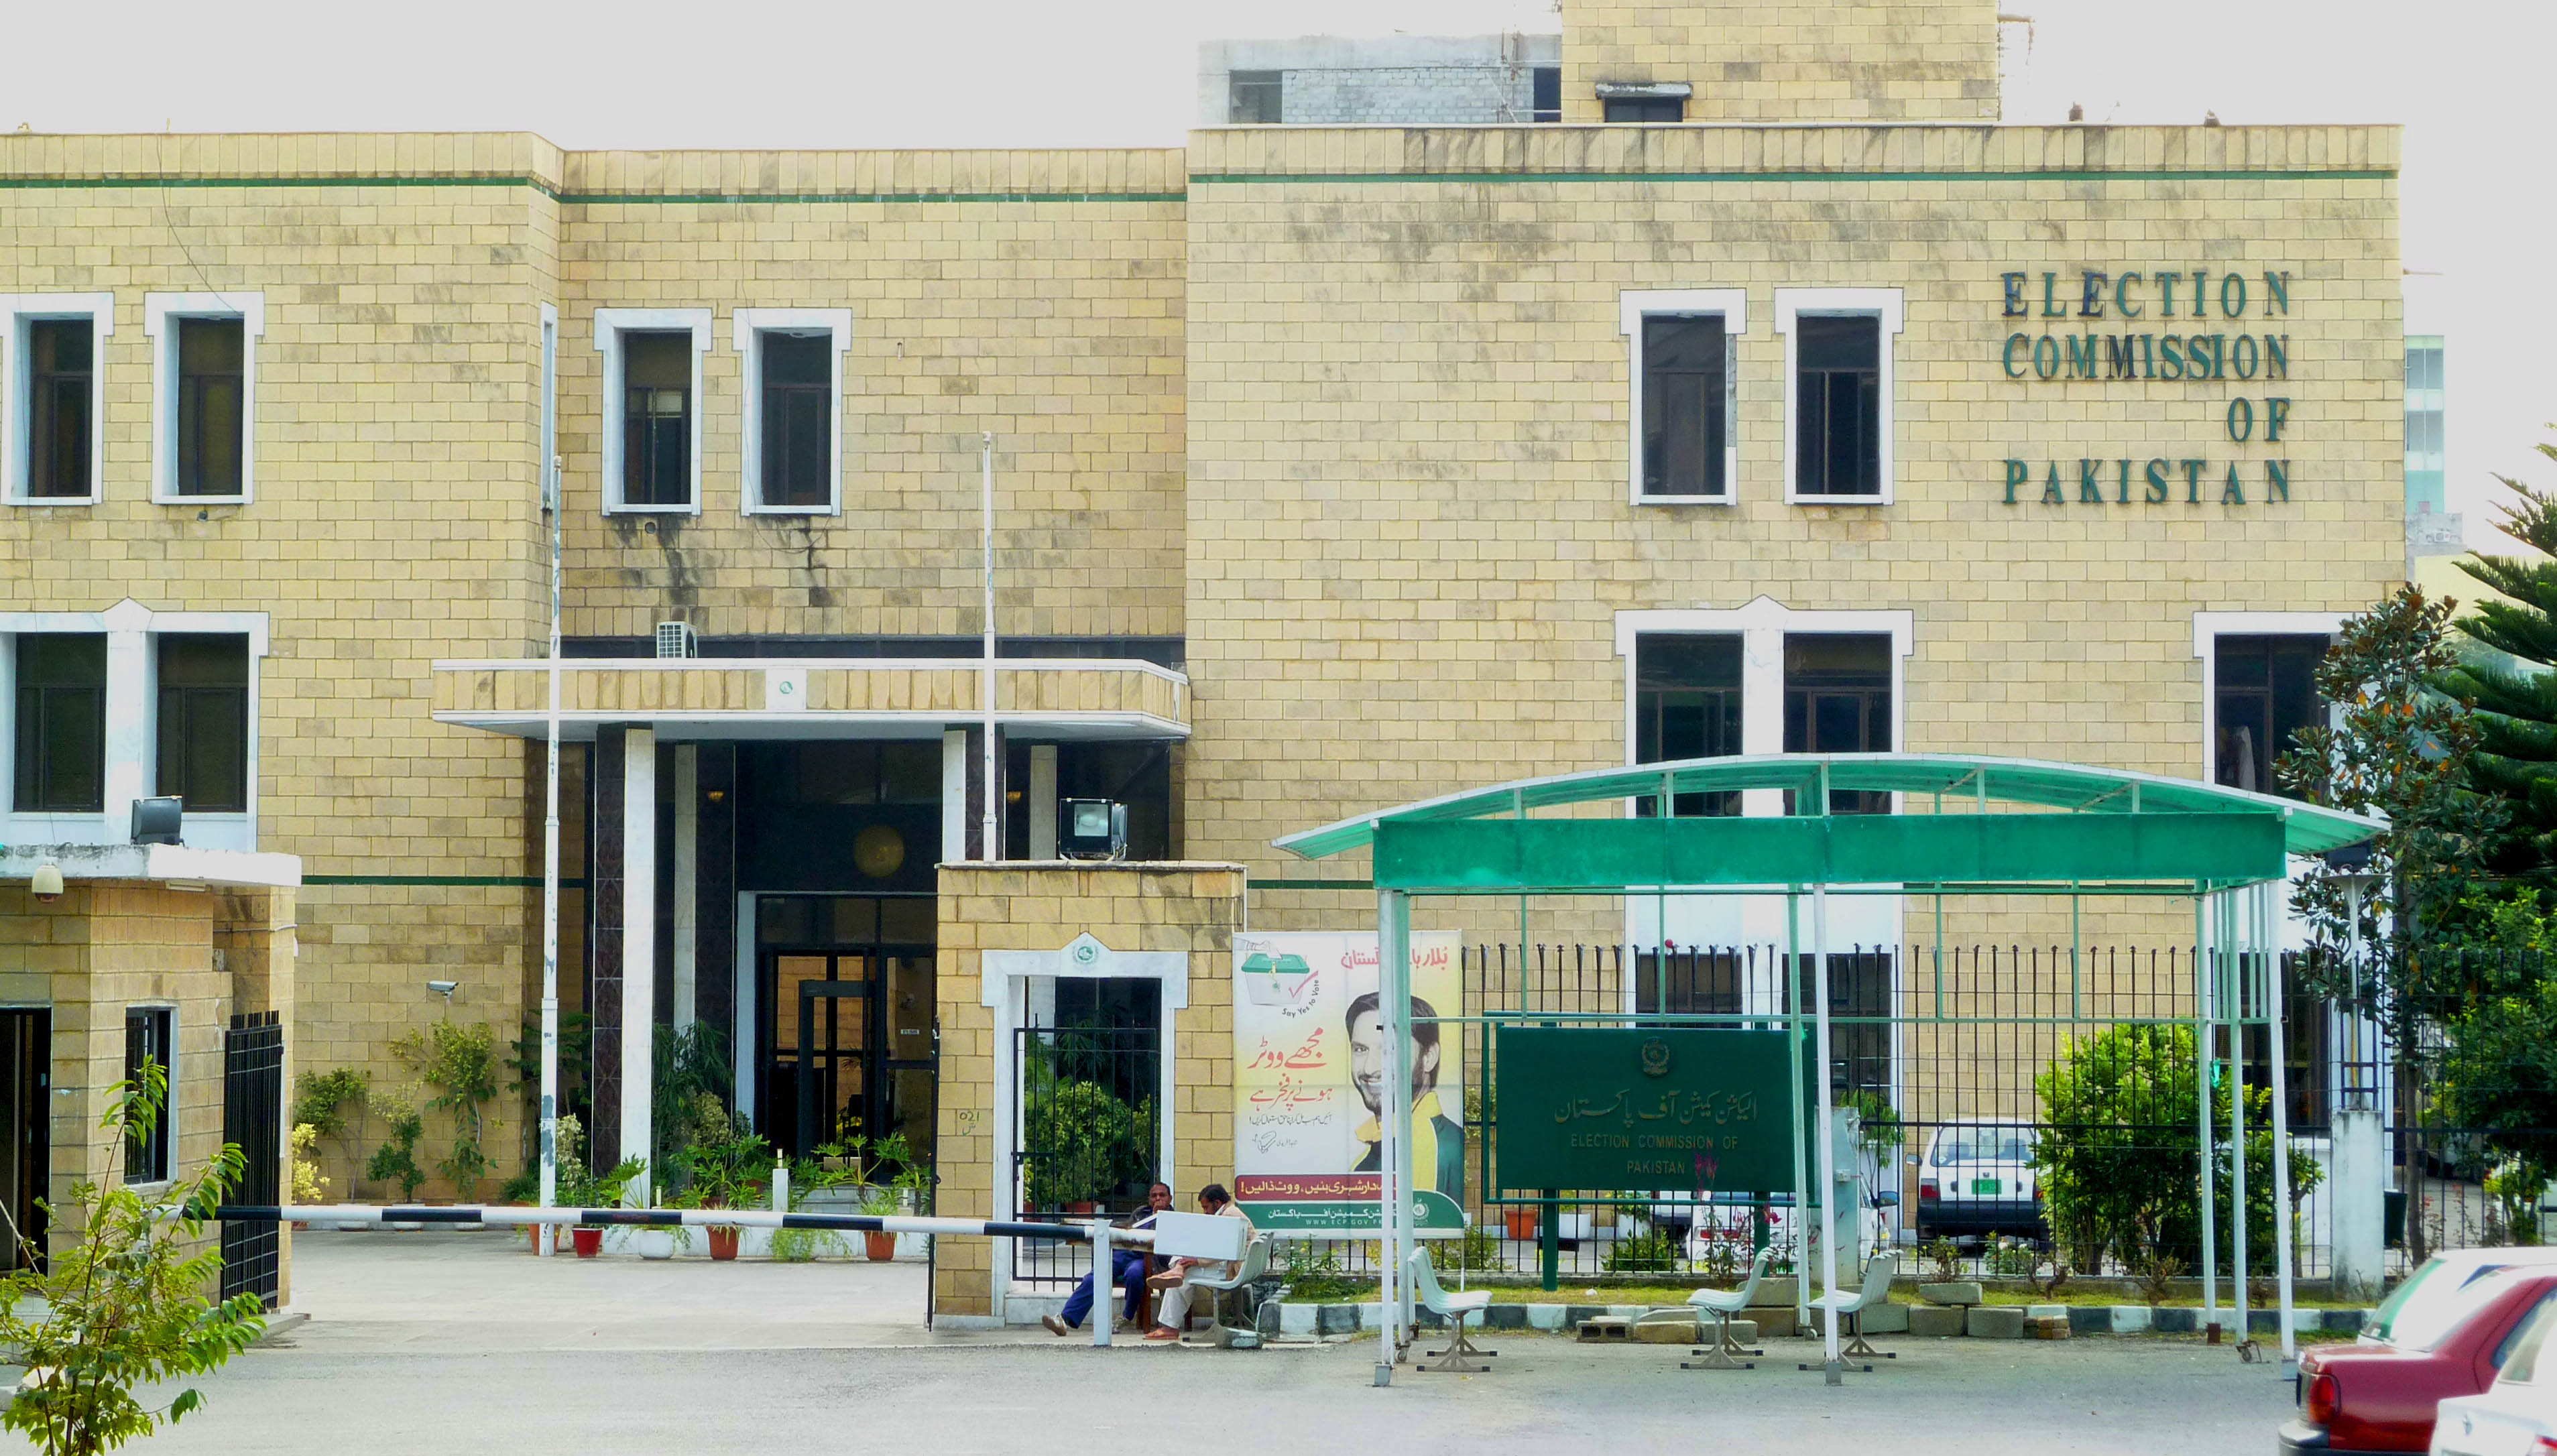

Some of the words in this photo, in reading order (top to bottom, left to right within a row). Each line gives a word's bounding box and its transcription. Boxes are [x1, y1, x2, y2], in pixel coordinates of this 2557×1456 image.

[2001, 271, 2290, 318] ELECTION
[2003, 332, 2289, 381] COMMISSION
[2227, 396, 2291, 442] OF
[2002, 459, 2291, 505] PAKISTAN
[1282, 1008, 1296, 1018] Say
[1298, 1006, 1310, 1015] Yes
[1311, 979, 1319, 996] Vote
[1246, 1034, 1284, 1069] ووٹر
[1284, 1026, 1327, 1069] مجھے
[1249, 1089, 1275, 1111] ہے
[1292, 1079, 1333, 1102] ہونے
[1553, 1088, 1630, 1128] پاکستان
[1637, 1089, 1681, 1120] آف
[1679, 1090, 1721, 1125] کمیشن
[1715, 1088, 1758, 1125] الیکشن
[1571, 1134, 1630, 1148] ELECTION
[1638, 1134, 1714, 1149] COMMISSION
[1722, 1135, 1738, 1150] OF
[1626, 1160, 1685, 1174] PAKISTAN
